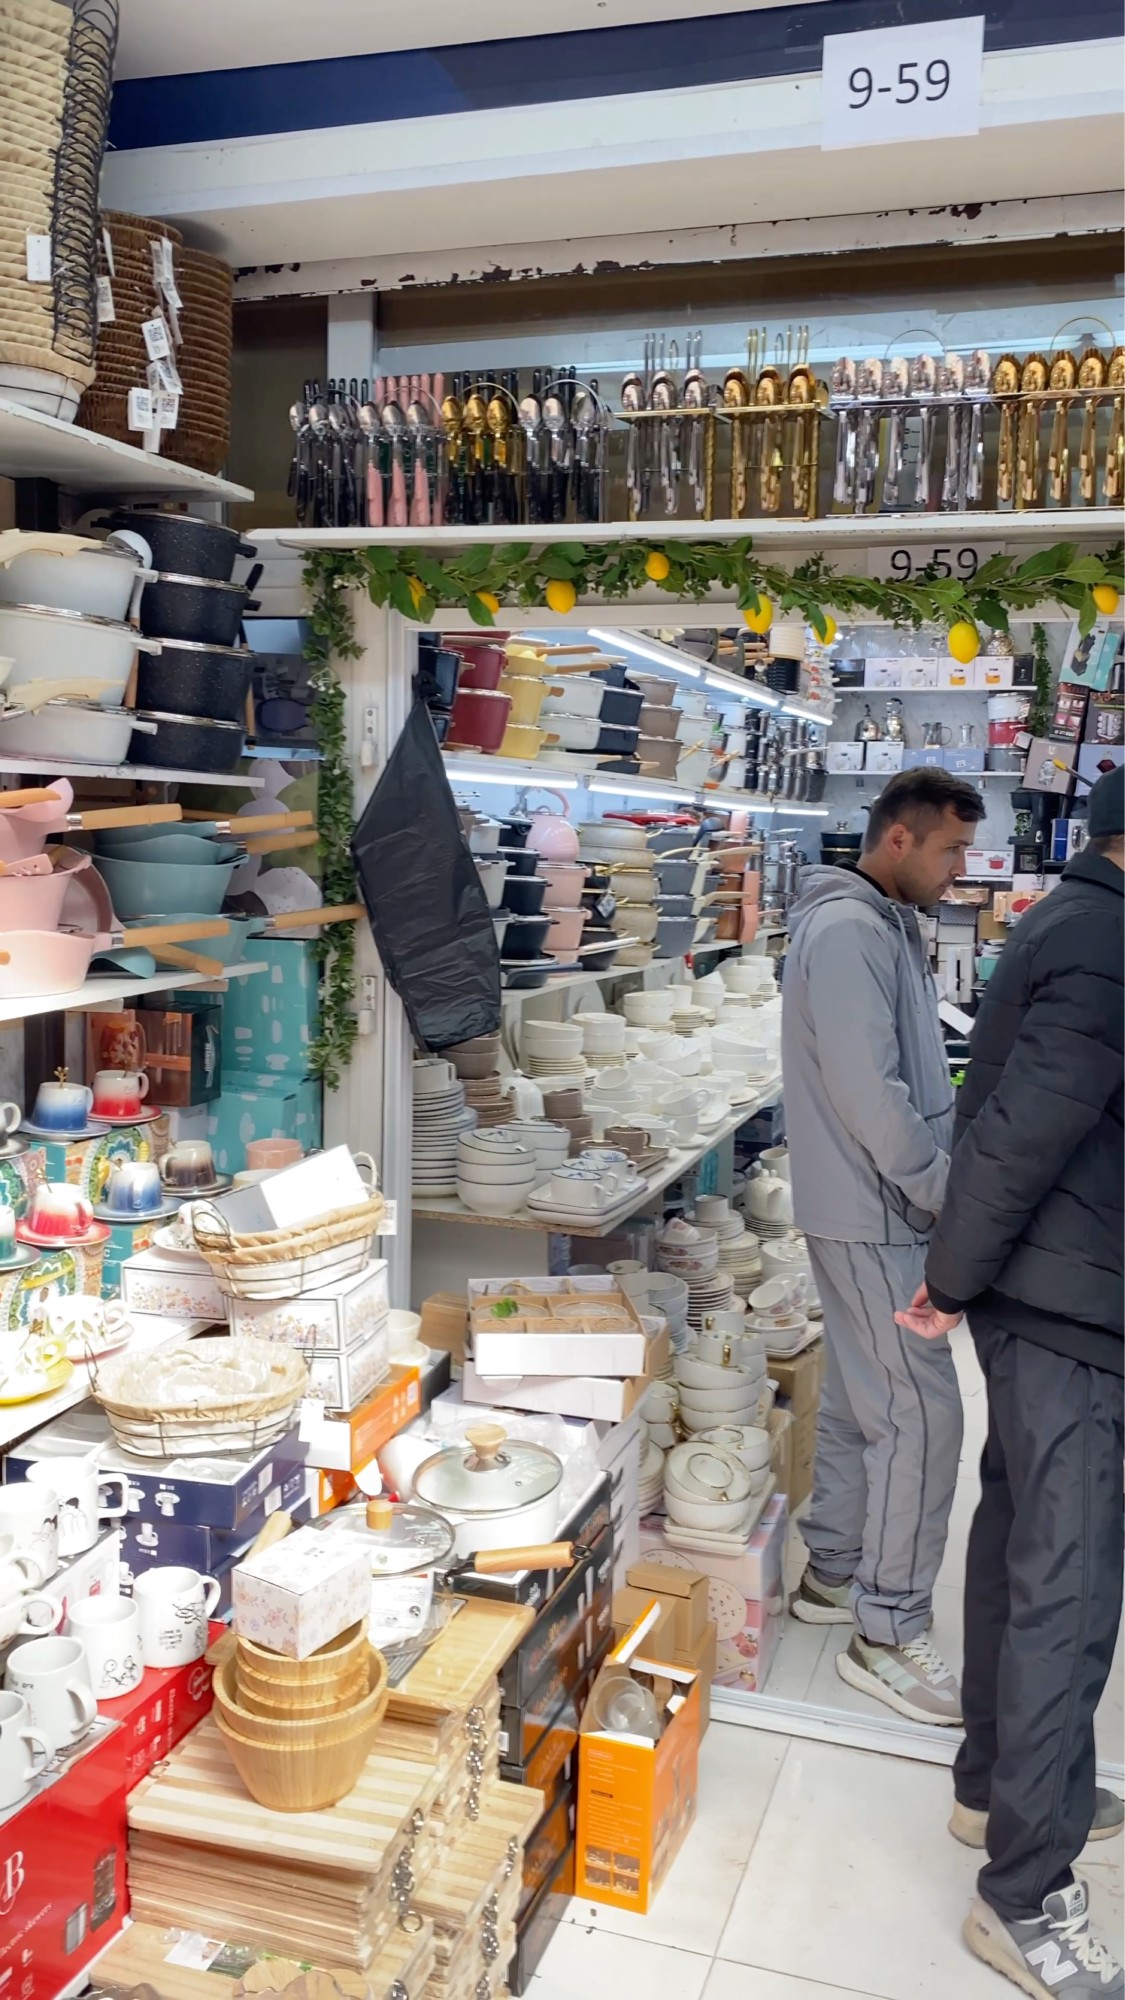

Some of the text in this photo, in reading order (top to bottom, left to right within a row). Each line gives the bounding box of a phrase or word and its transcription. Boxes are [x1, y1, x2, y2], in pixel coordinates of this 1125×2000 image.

[848, 59, 950, 109] 9-59
[891, 548, 979, 582] 9-59
[1024, 1940, 1079, 1986] N
